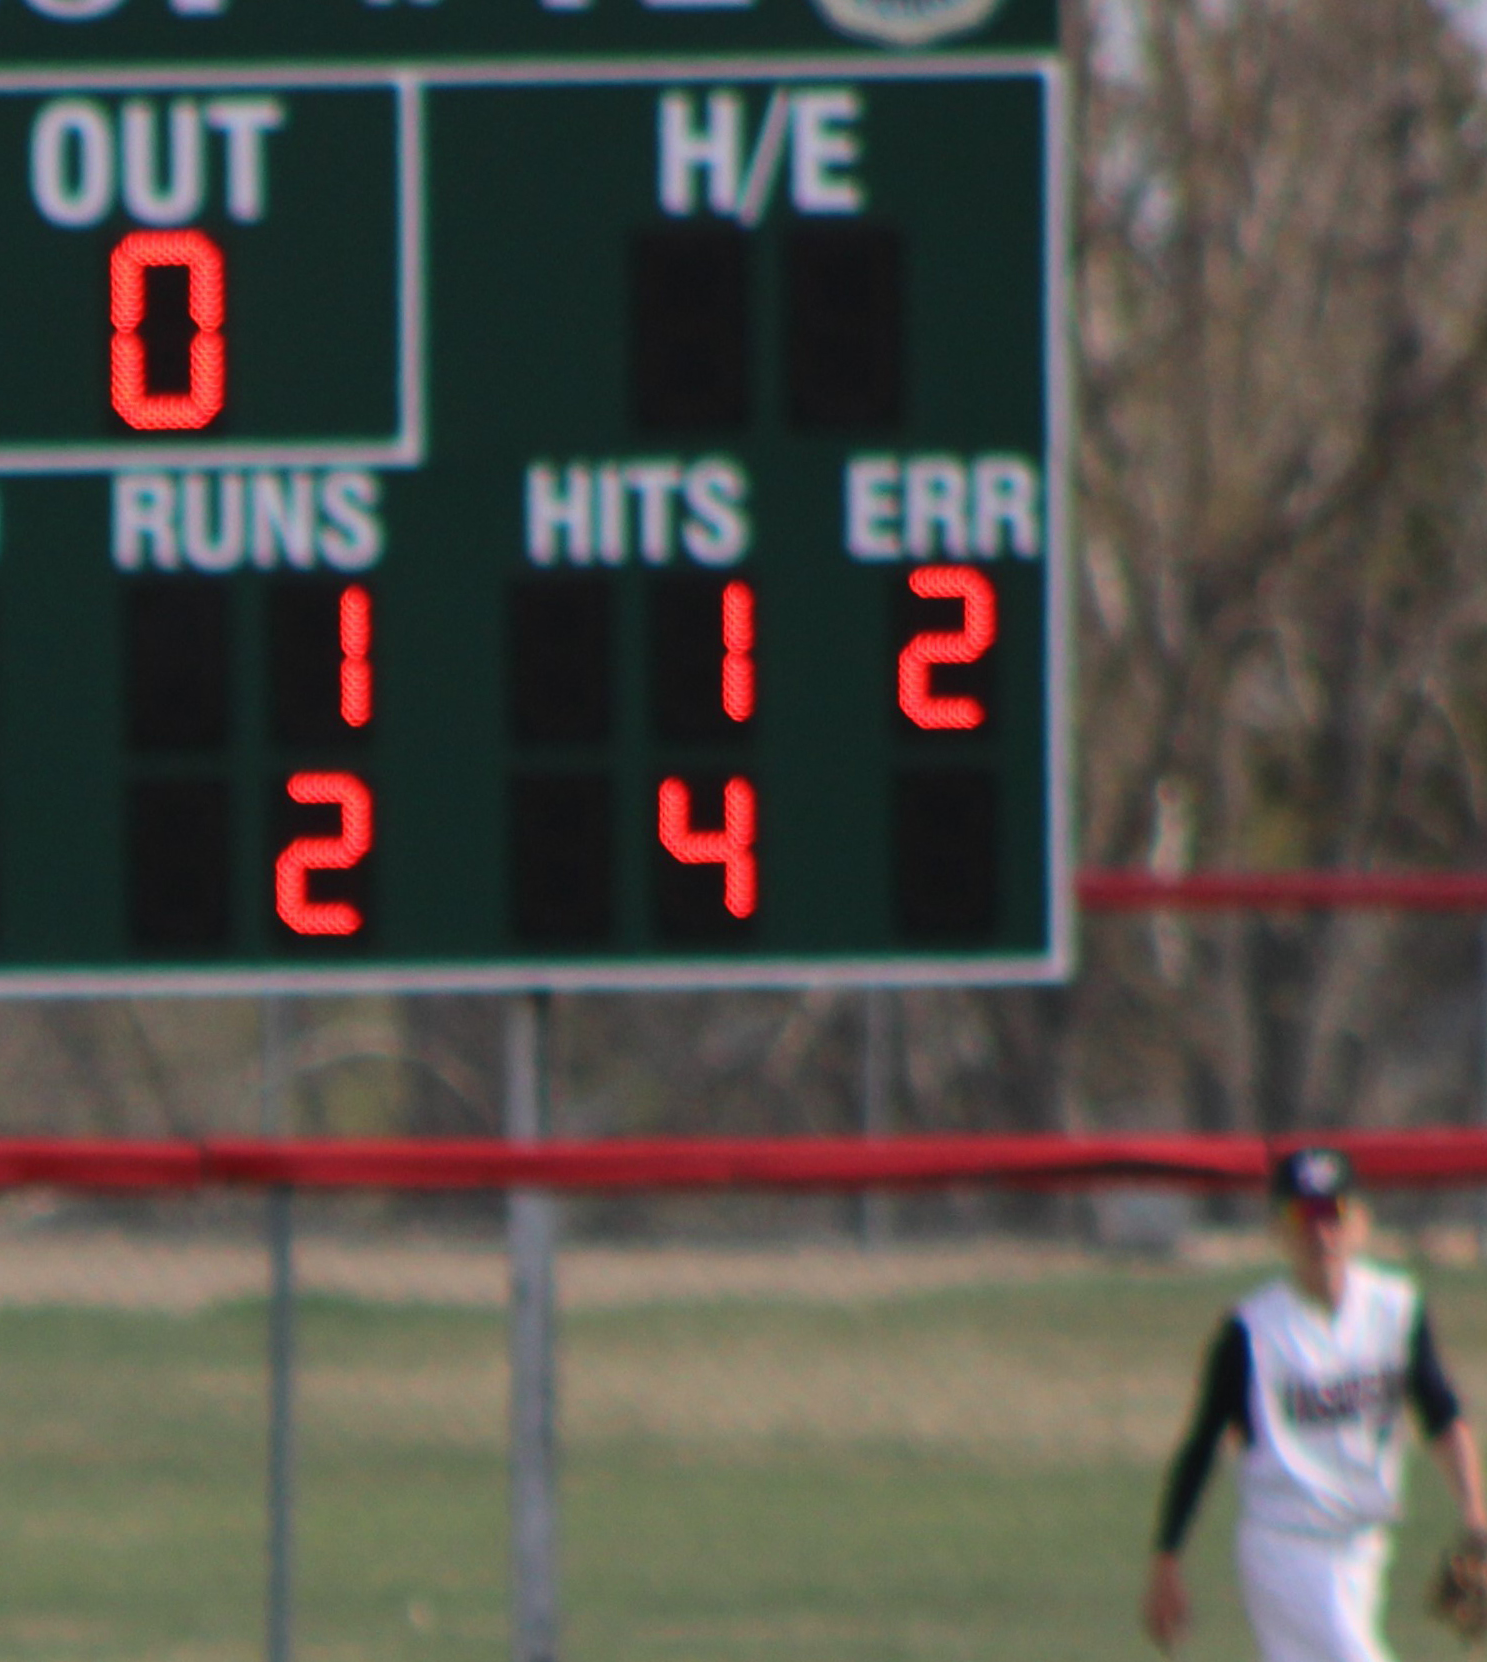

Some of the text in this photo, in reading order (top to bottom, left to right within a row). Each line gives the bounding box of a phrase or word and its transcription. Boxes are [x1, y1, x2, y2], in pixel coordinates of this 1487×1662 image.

[34, 100, 281, 224] OUT
[663, 91, 859, 221] H/E
[110, 230, 224, 429] 0
[116, 472, 379, 568] RUNS
[530, 461, 746, 561] HITS
[849, 458, 1038, 556] ERR
[340, 588, 370, 726] 1
[723, 584, 753, 722] 1
[899, 566, 995, 729] 2
[276, 773, 371, 935] 2
[659, 779, 755, 918] 4
